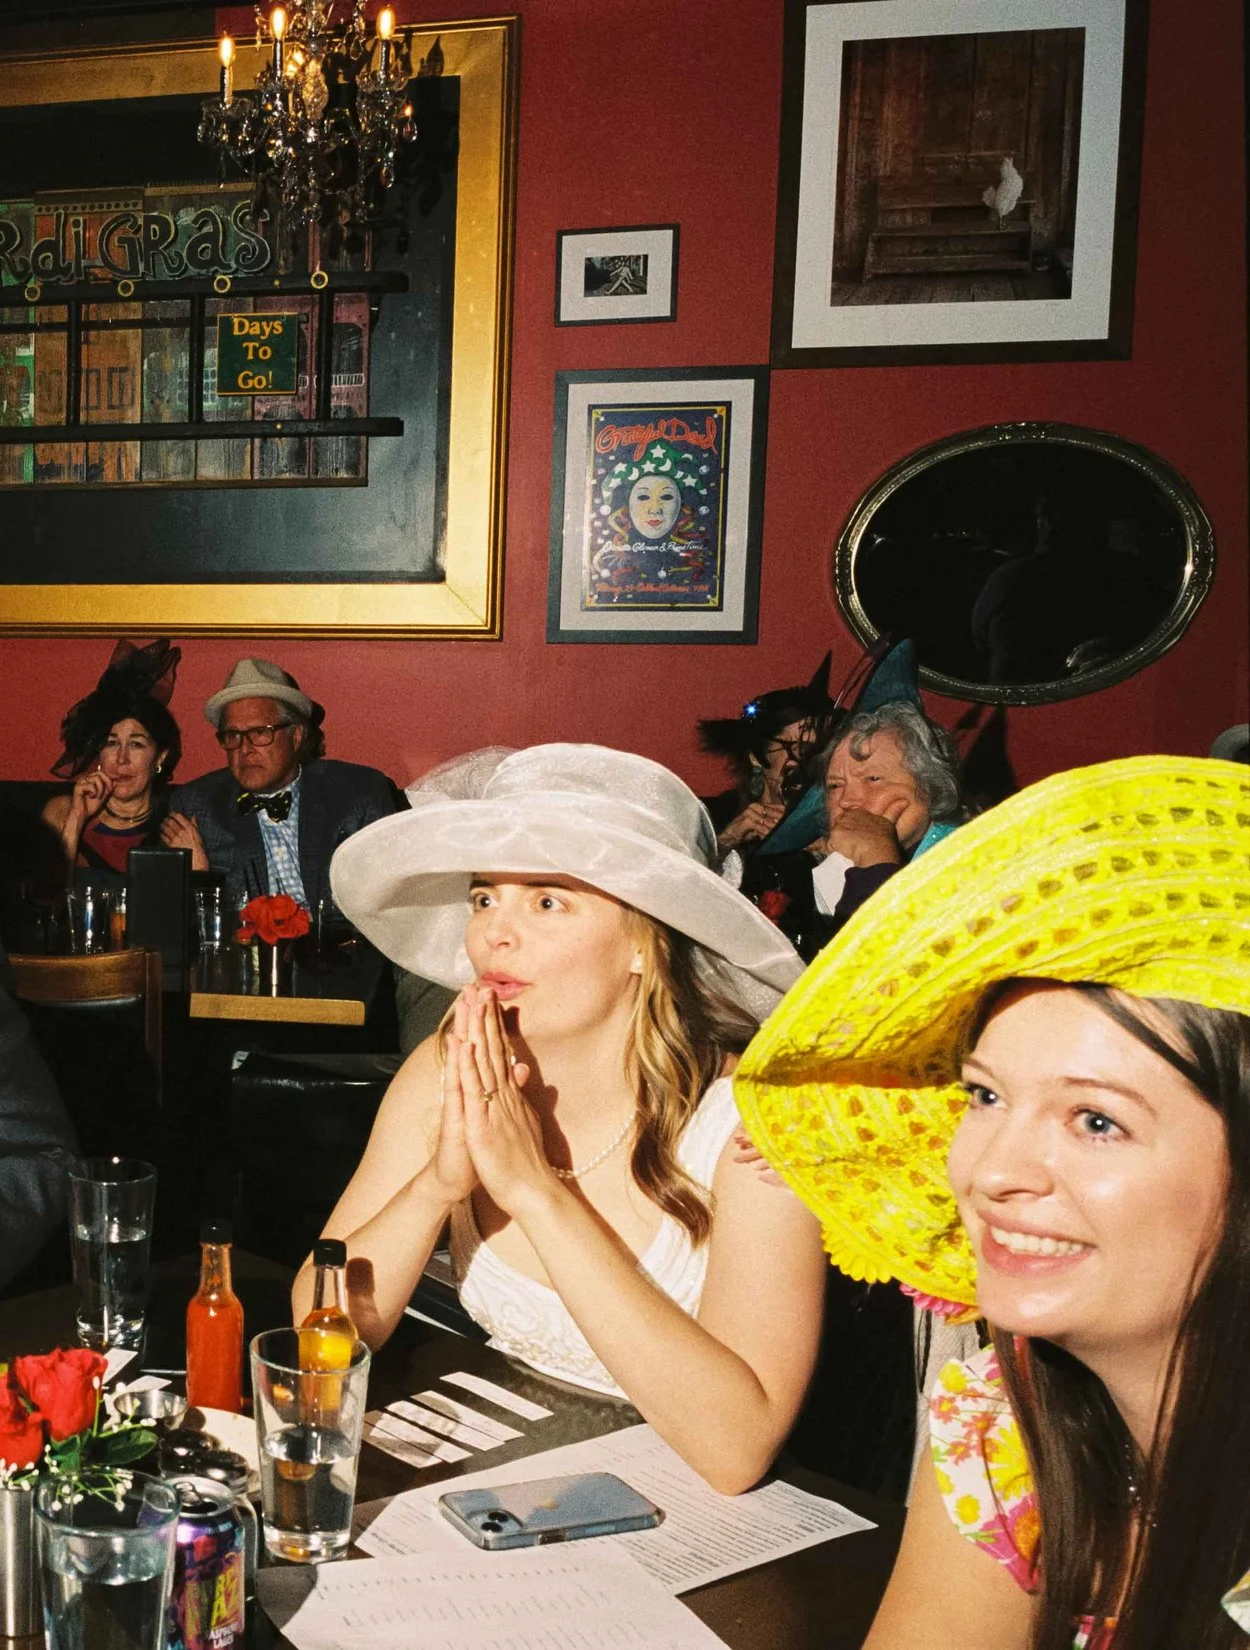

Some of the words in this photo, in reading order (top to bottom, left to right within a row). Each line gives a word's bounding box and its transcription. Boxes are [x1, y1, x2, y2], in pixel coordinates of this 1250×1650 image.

[233, 317, 283, 339] Days
[242, 342, 272, 360] To
[237, 370, 274, 389] Go!
[595, 419, 666, 462] Grateful
[663, 416, 719, 456] Dead
